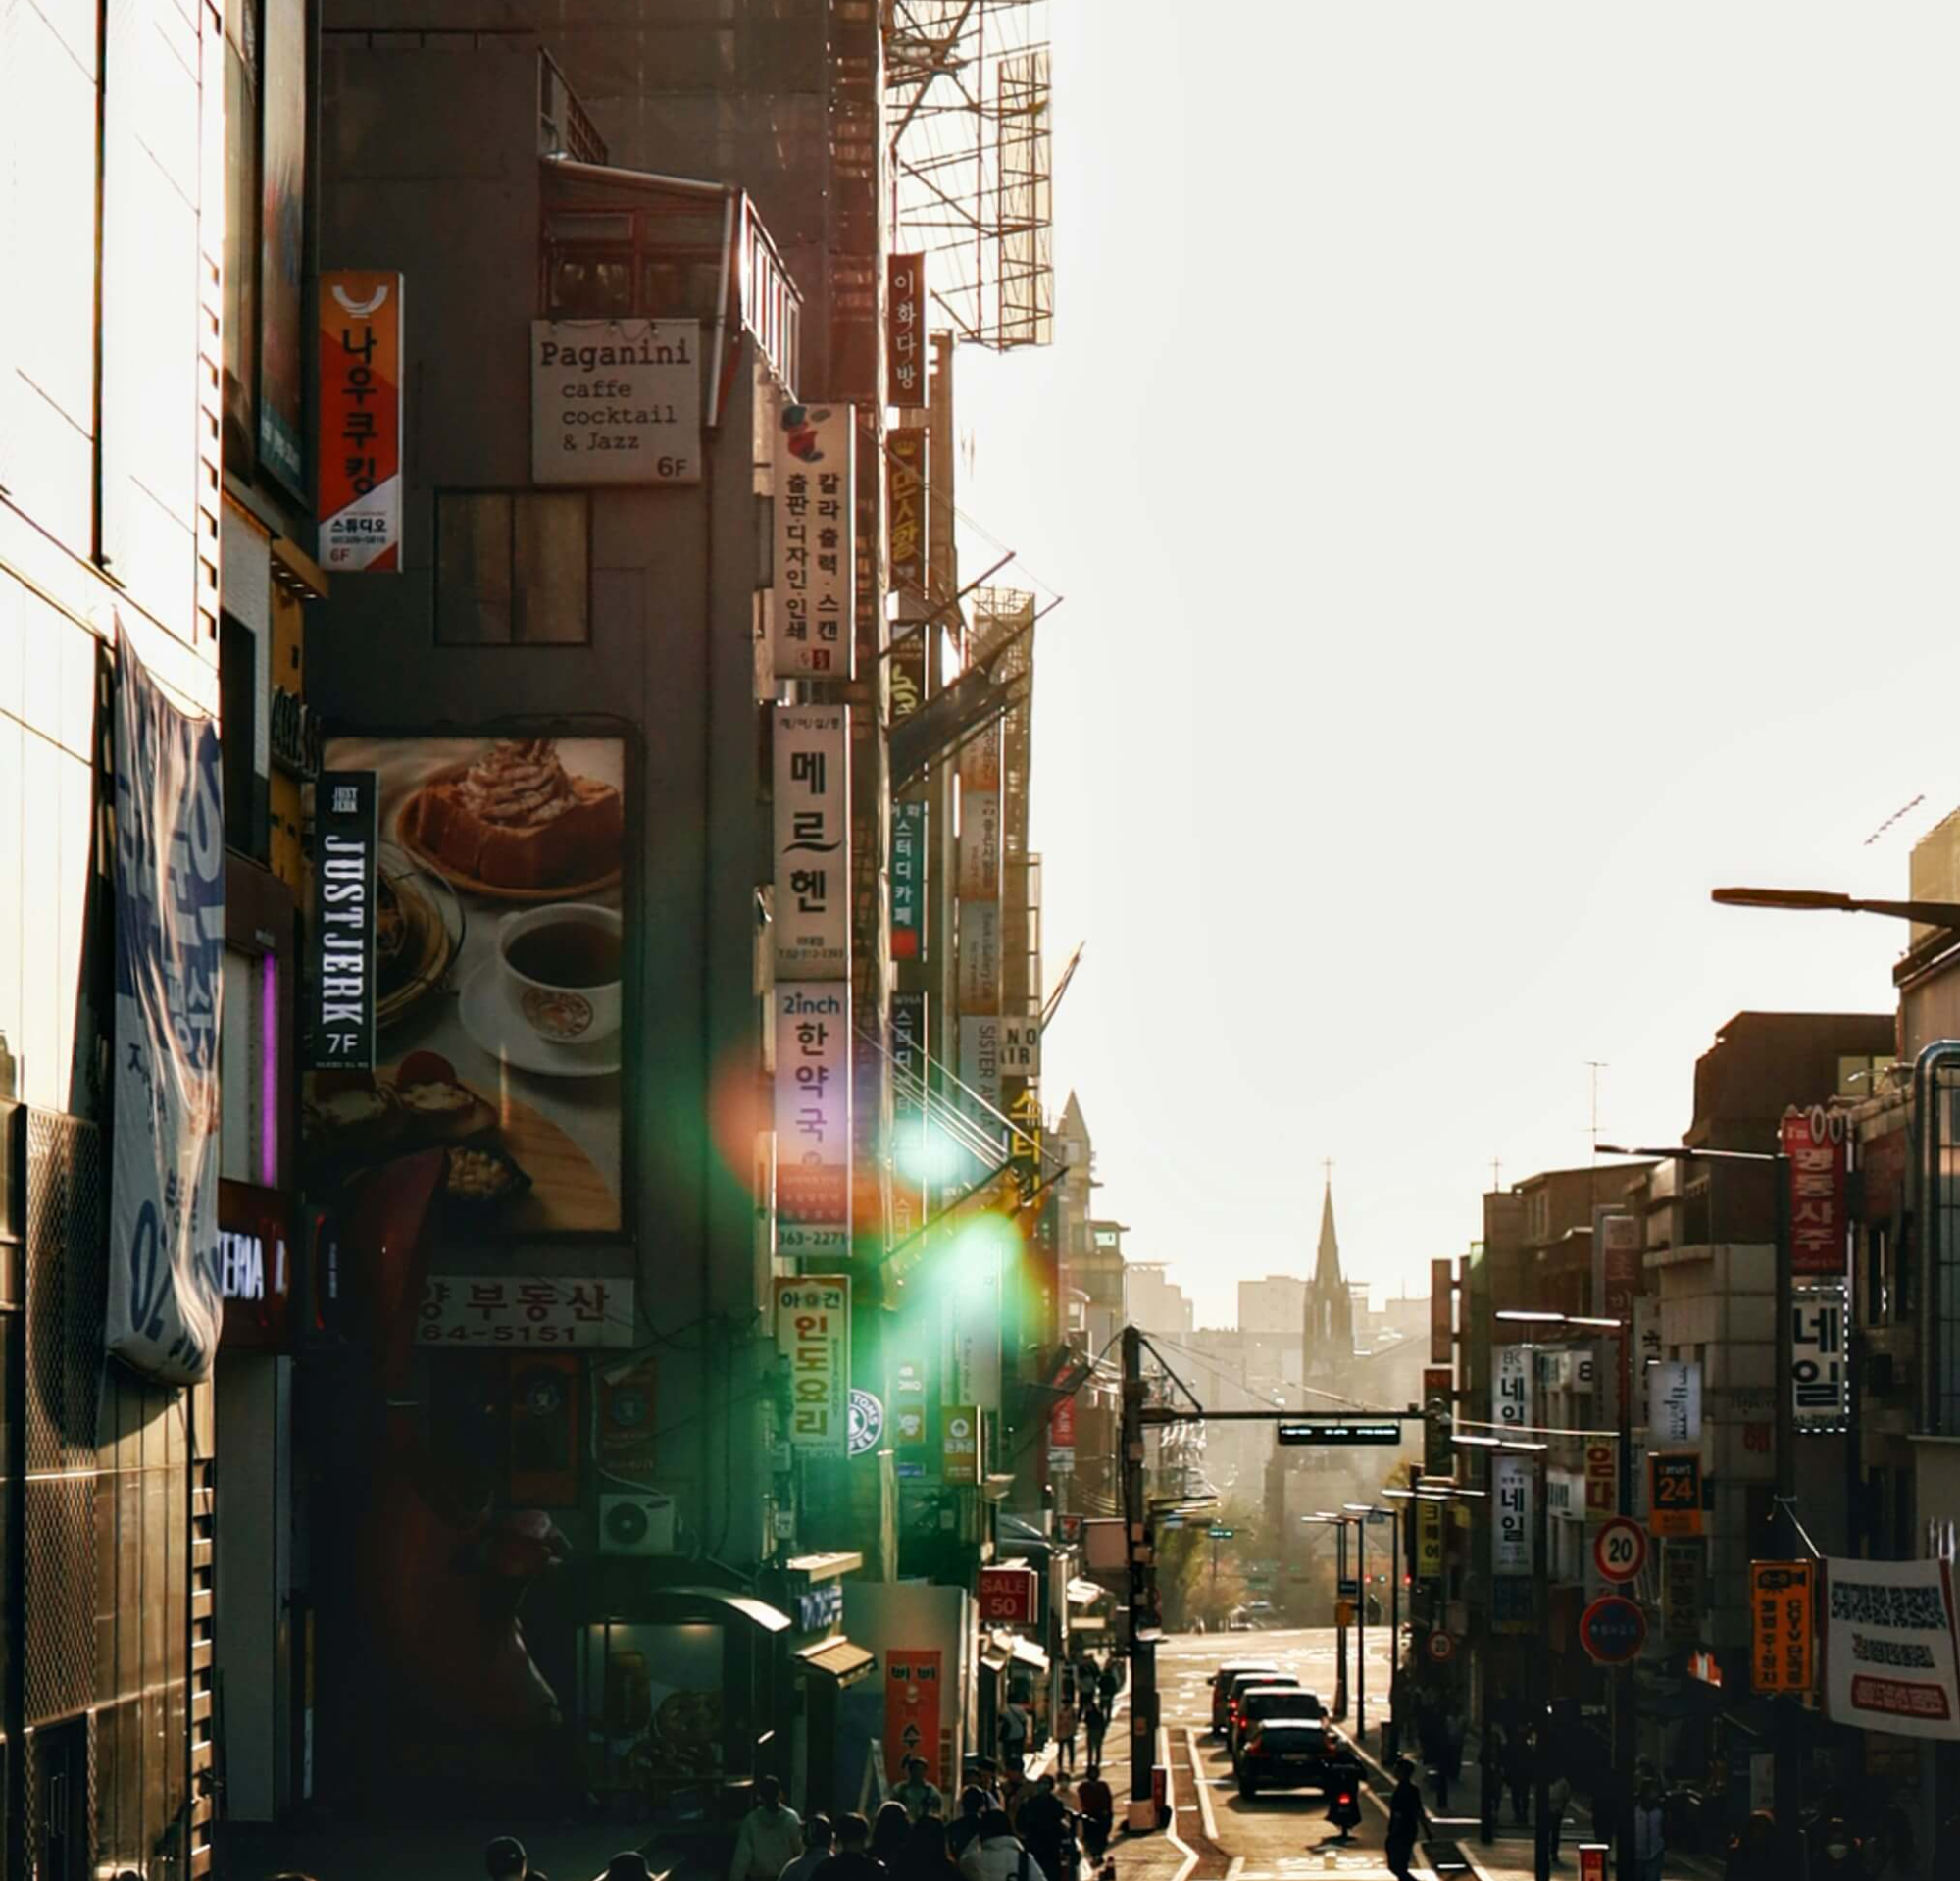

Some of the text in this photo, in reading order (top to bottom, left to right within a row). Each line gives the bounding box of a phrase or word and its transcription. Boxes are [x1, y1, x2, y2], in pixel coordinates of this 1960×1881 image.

[893, 268, 918, 390] 이화다방
[540, 338, 691, 373] Paganini
[561, 379, 632, 399] caffe
[341, 326, 378, 497] 나우쿠킹
[561, 404, 678, 426] cocktail
[563, 432, 640, 452] & Jazz
[656, 456, 688, 478] 6F
[329, 518, 388, 534] 스튜디오
[329, 548, 350, 562] 6F
[782, 751, 843, 914] 메르헨
[782, 991, 840, 1015] 2inch
[326, 1034, 358, 1054] 7F
[795, 1022, 829, 1144] 한약국
[1792, 1307, 1840, 1407] 네일
[1659, 1477, 1695, 1503] 24
[1501, 1488, 1525, 1543] 네일
[1608, 1537, 1633, 1563] 20
[981, 1579, 1027, 1595] SALE
[990, 1598, 1018, 1616] 50
